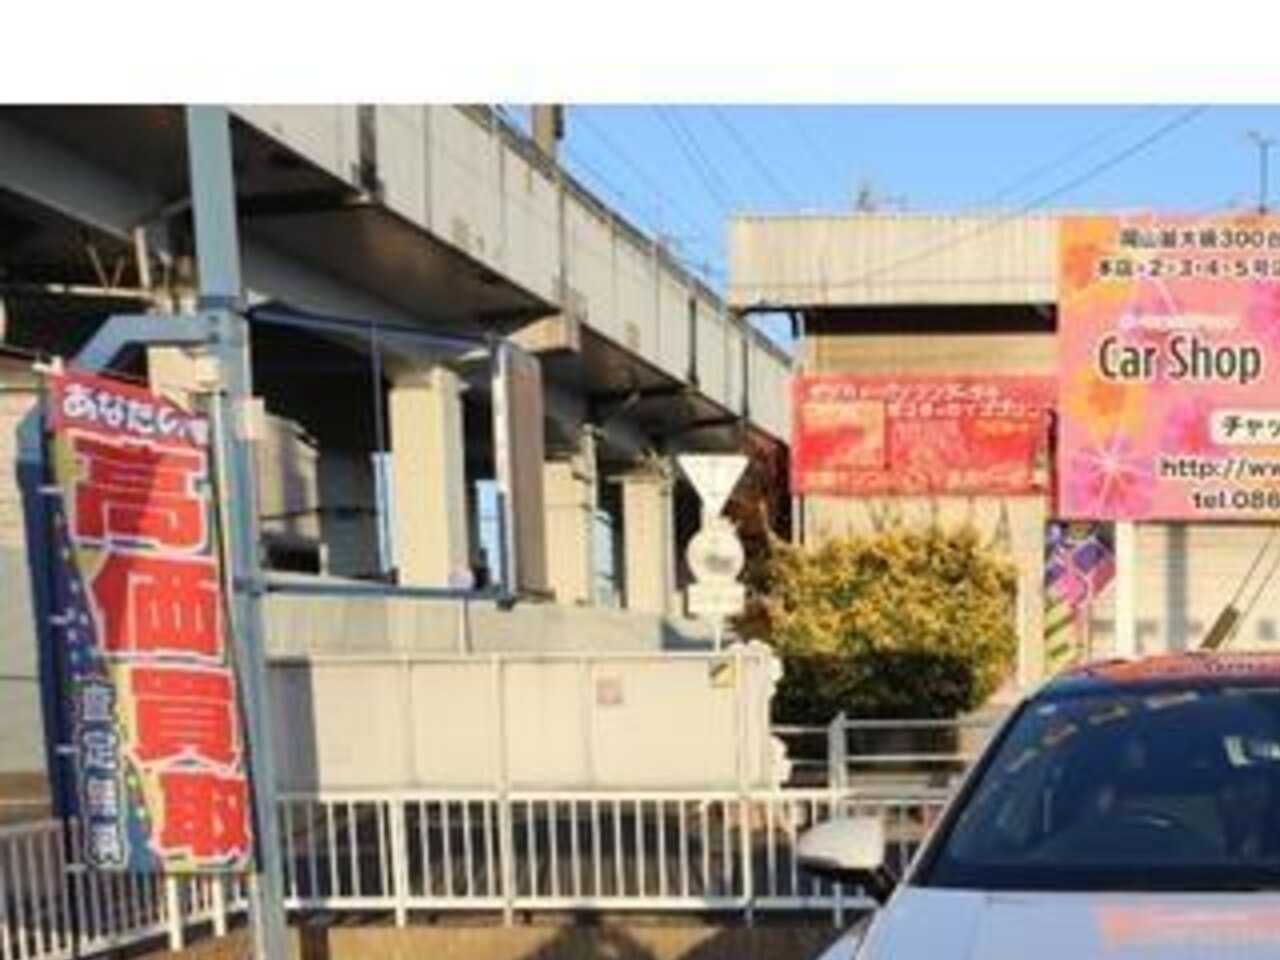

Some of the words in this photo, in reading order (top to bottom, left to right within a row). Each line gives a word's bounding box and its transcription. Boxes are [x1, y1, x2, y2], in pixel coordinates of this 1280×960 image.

[1100, 336, 1156, 378] Car
[1169, 336, 1261, 384] Shop
[68, 430, 254, 867] 高価買取
